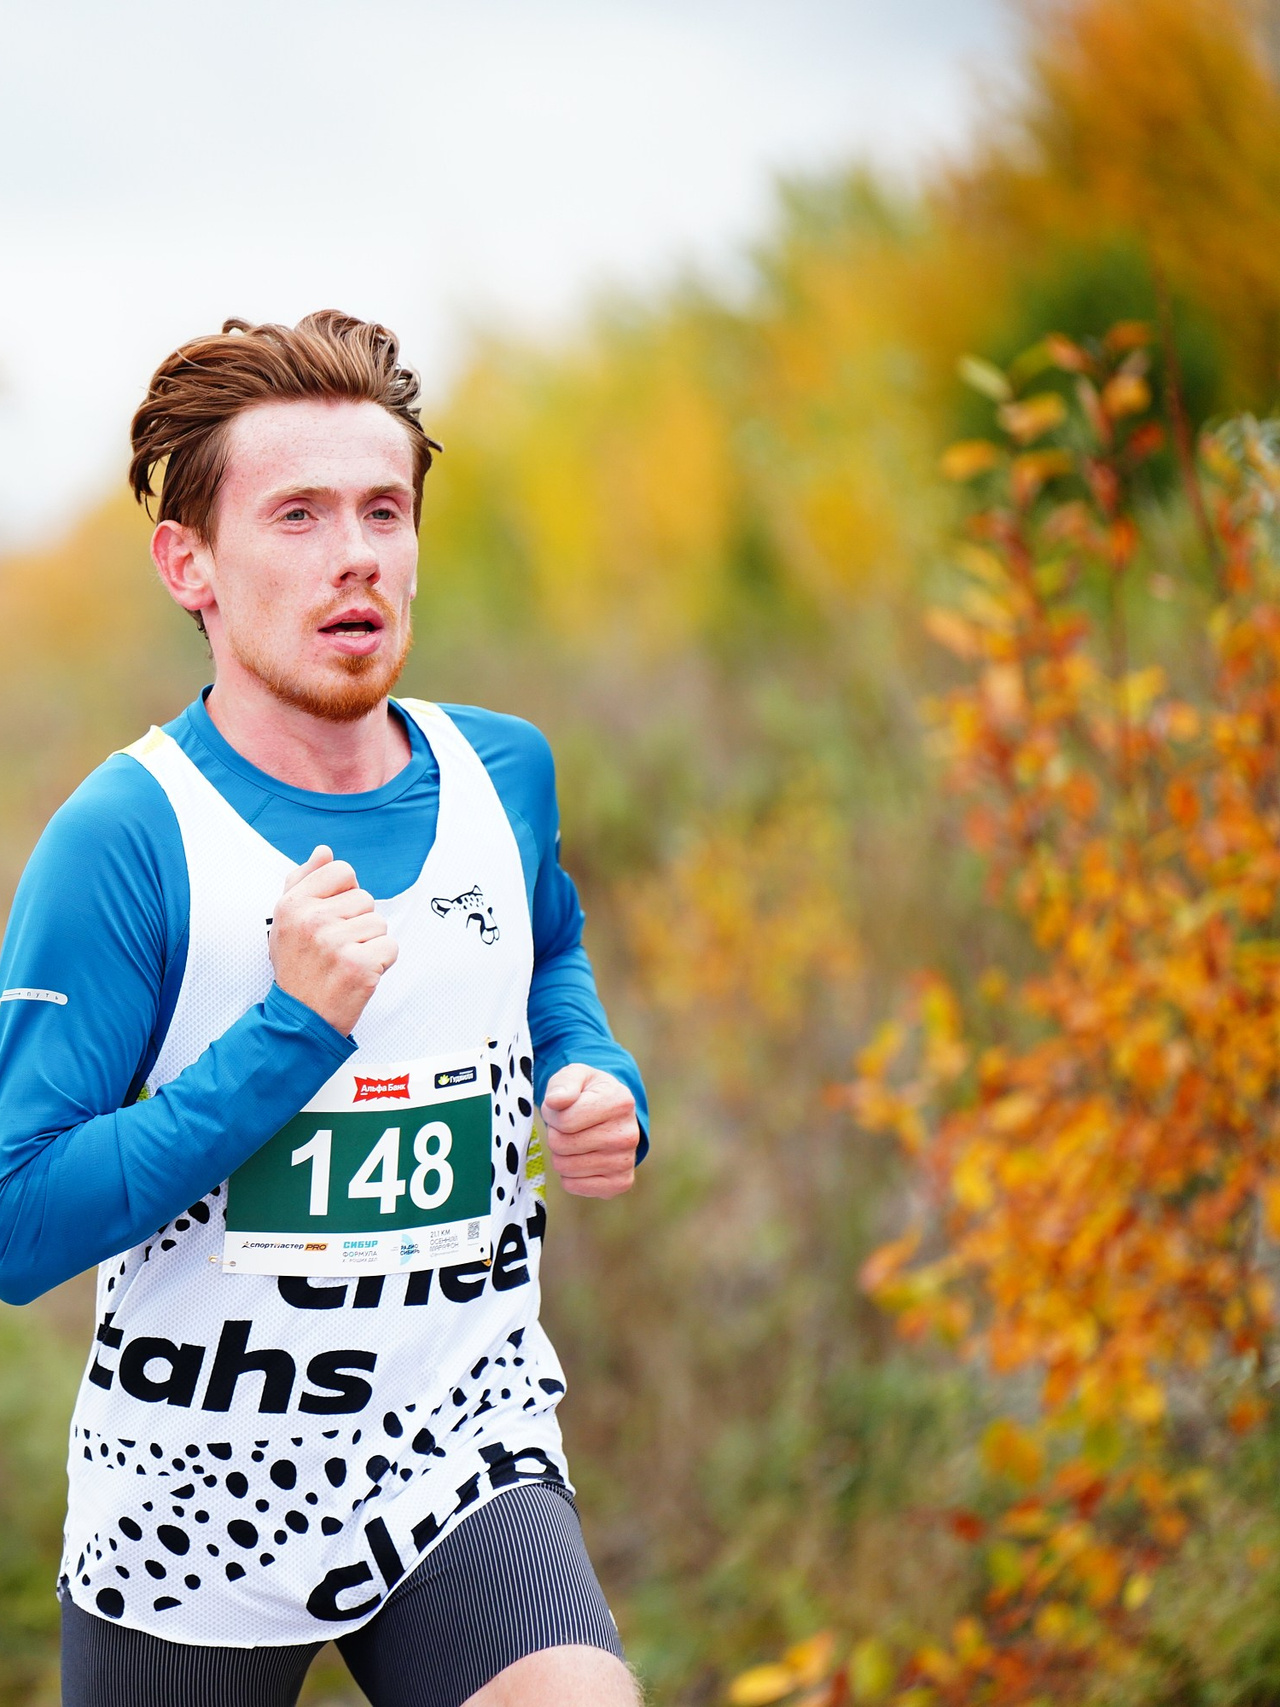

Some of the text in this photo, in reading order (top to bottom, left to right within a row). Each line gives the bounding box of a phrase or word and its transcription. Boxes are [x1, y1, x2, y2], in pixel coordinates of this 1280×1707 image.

[360, 1083, 407, 1096] Альфа Банк
[290, 1120, 455, 1217] 148
[305, 1243, 328, 1251] PRO
[343, 1240, 379, 1249] СИБУР
[342, 1250, 378, 1258] ФОРМУЛА
[88, 1311, 378, 1416] tahs
